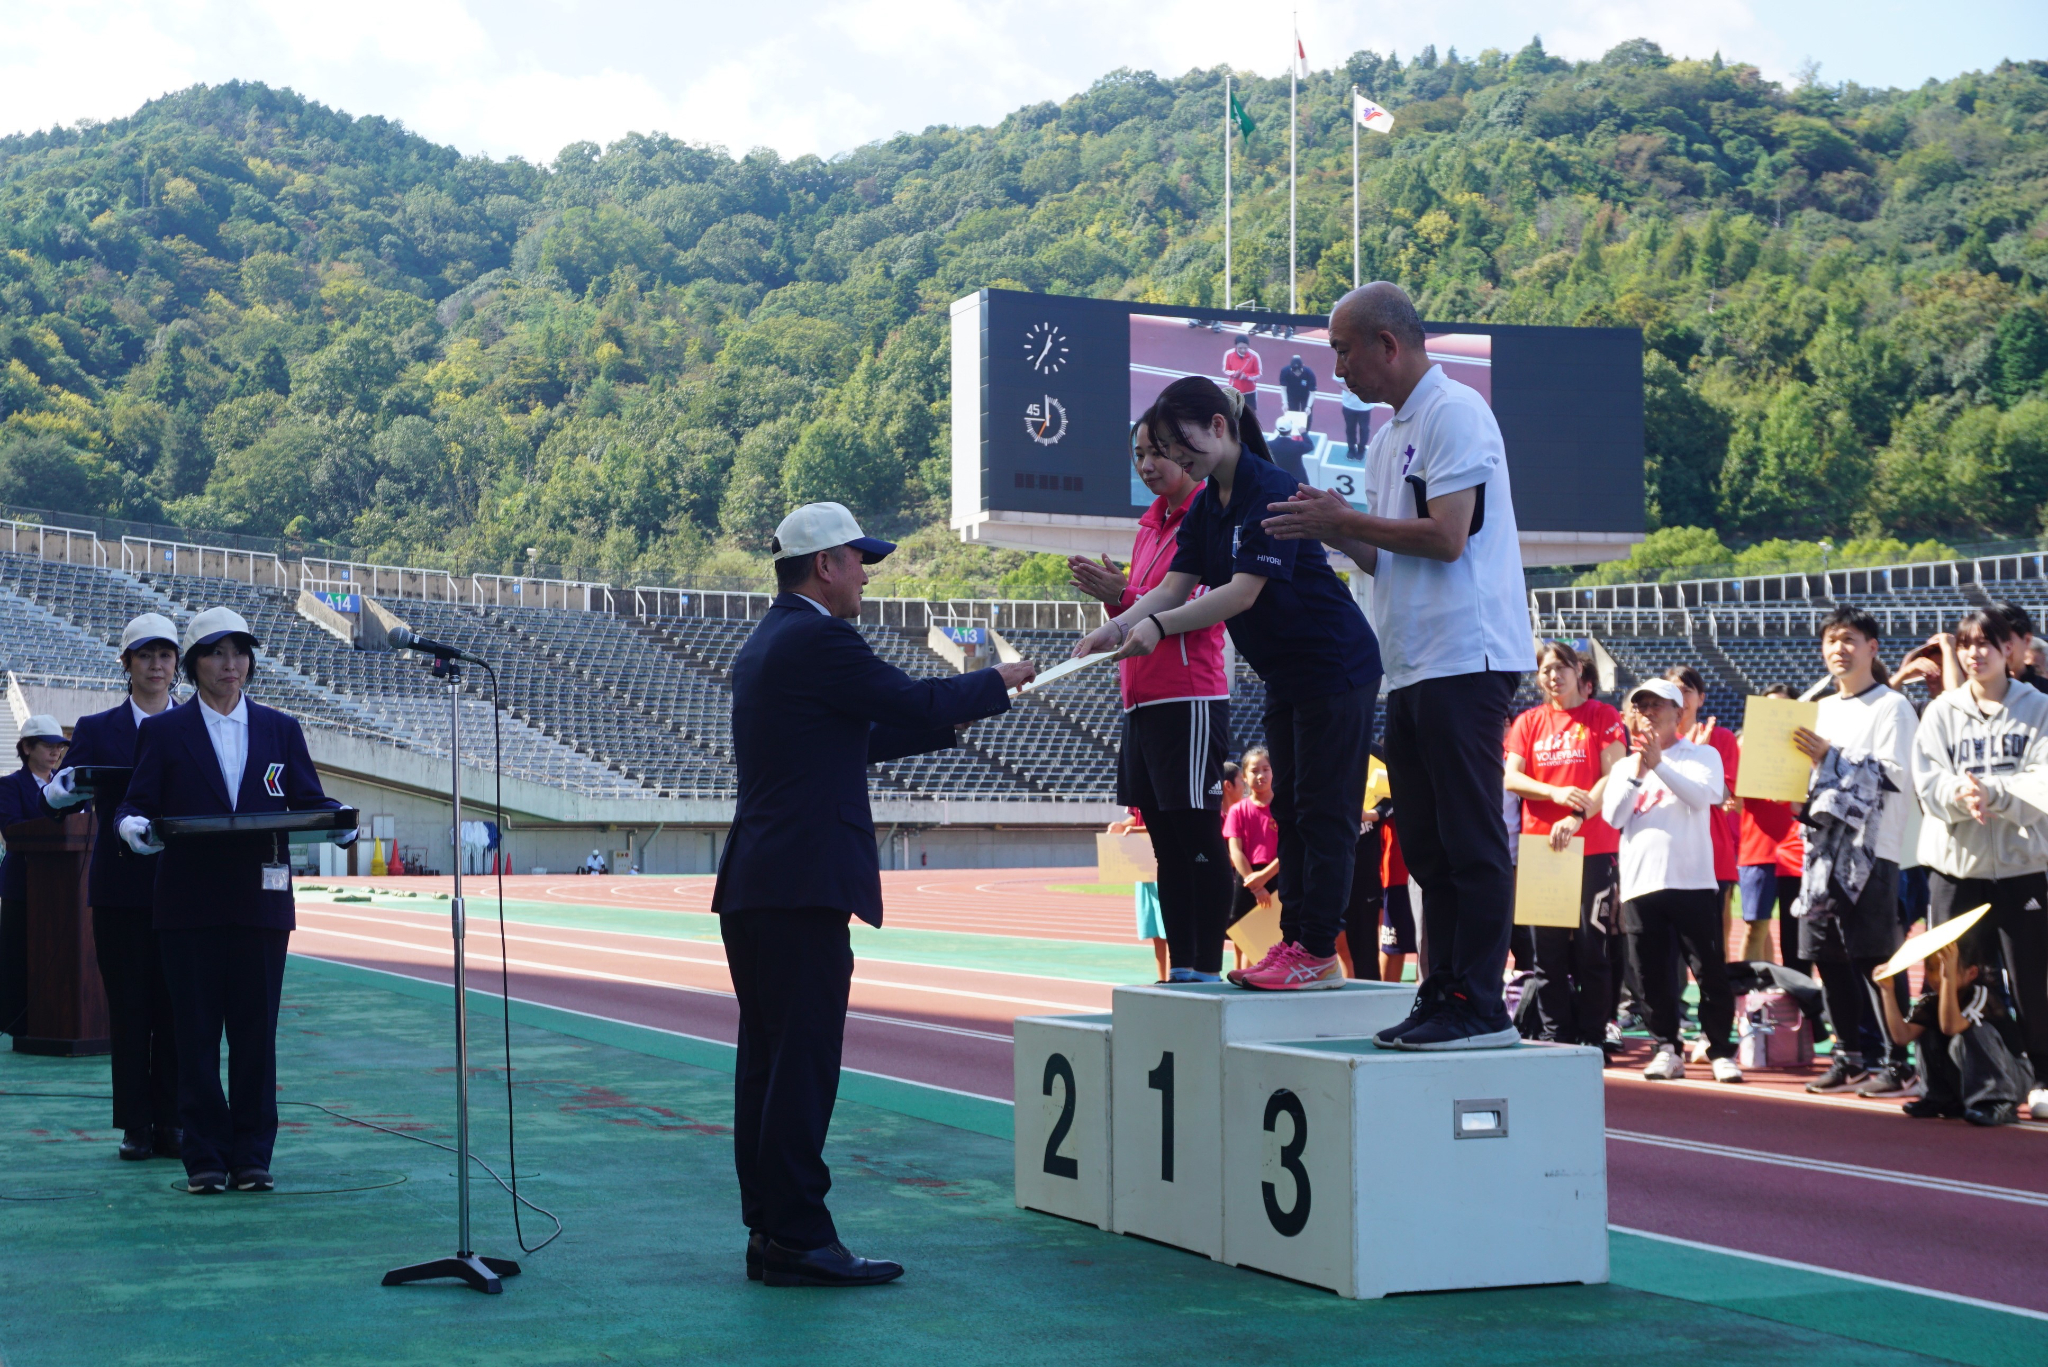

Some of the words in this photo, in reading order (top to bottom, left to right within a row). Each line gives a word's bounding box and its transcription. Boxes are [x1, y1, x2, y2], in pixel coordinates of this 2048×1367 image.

[1026, 404, 1040, 416] 45
[1336, 474, 1355, 496] 3
[1257, 554, 1282, 566] HIYORI
[324, 593, 352, 612] A14
[951, 628, 978, 643] A13
[1536, 748, 1587, 762] VOLLEYBALL
[1042, 1052, 1079, 1181] 2
[1148, 1051, 1175, 1183] 1
[1261, 1088, 1312, 1238] 3
